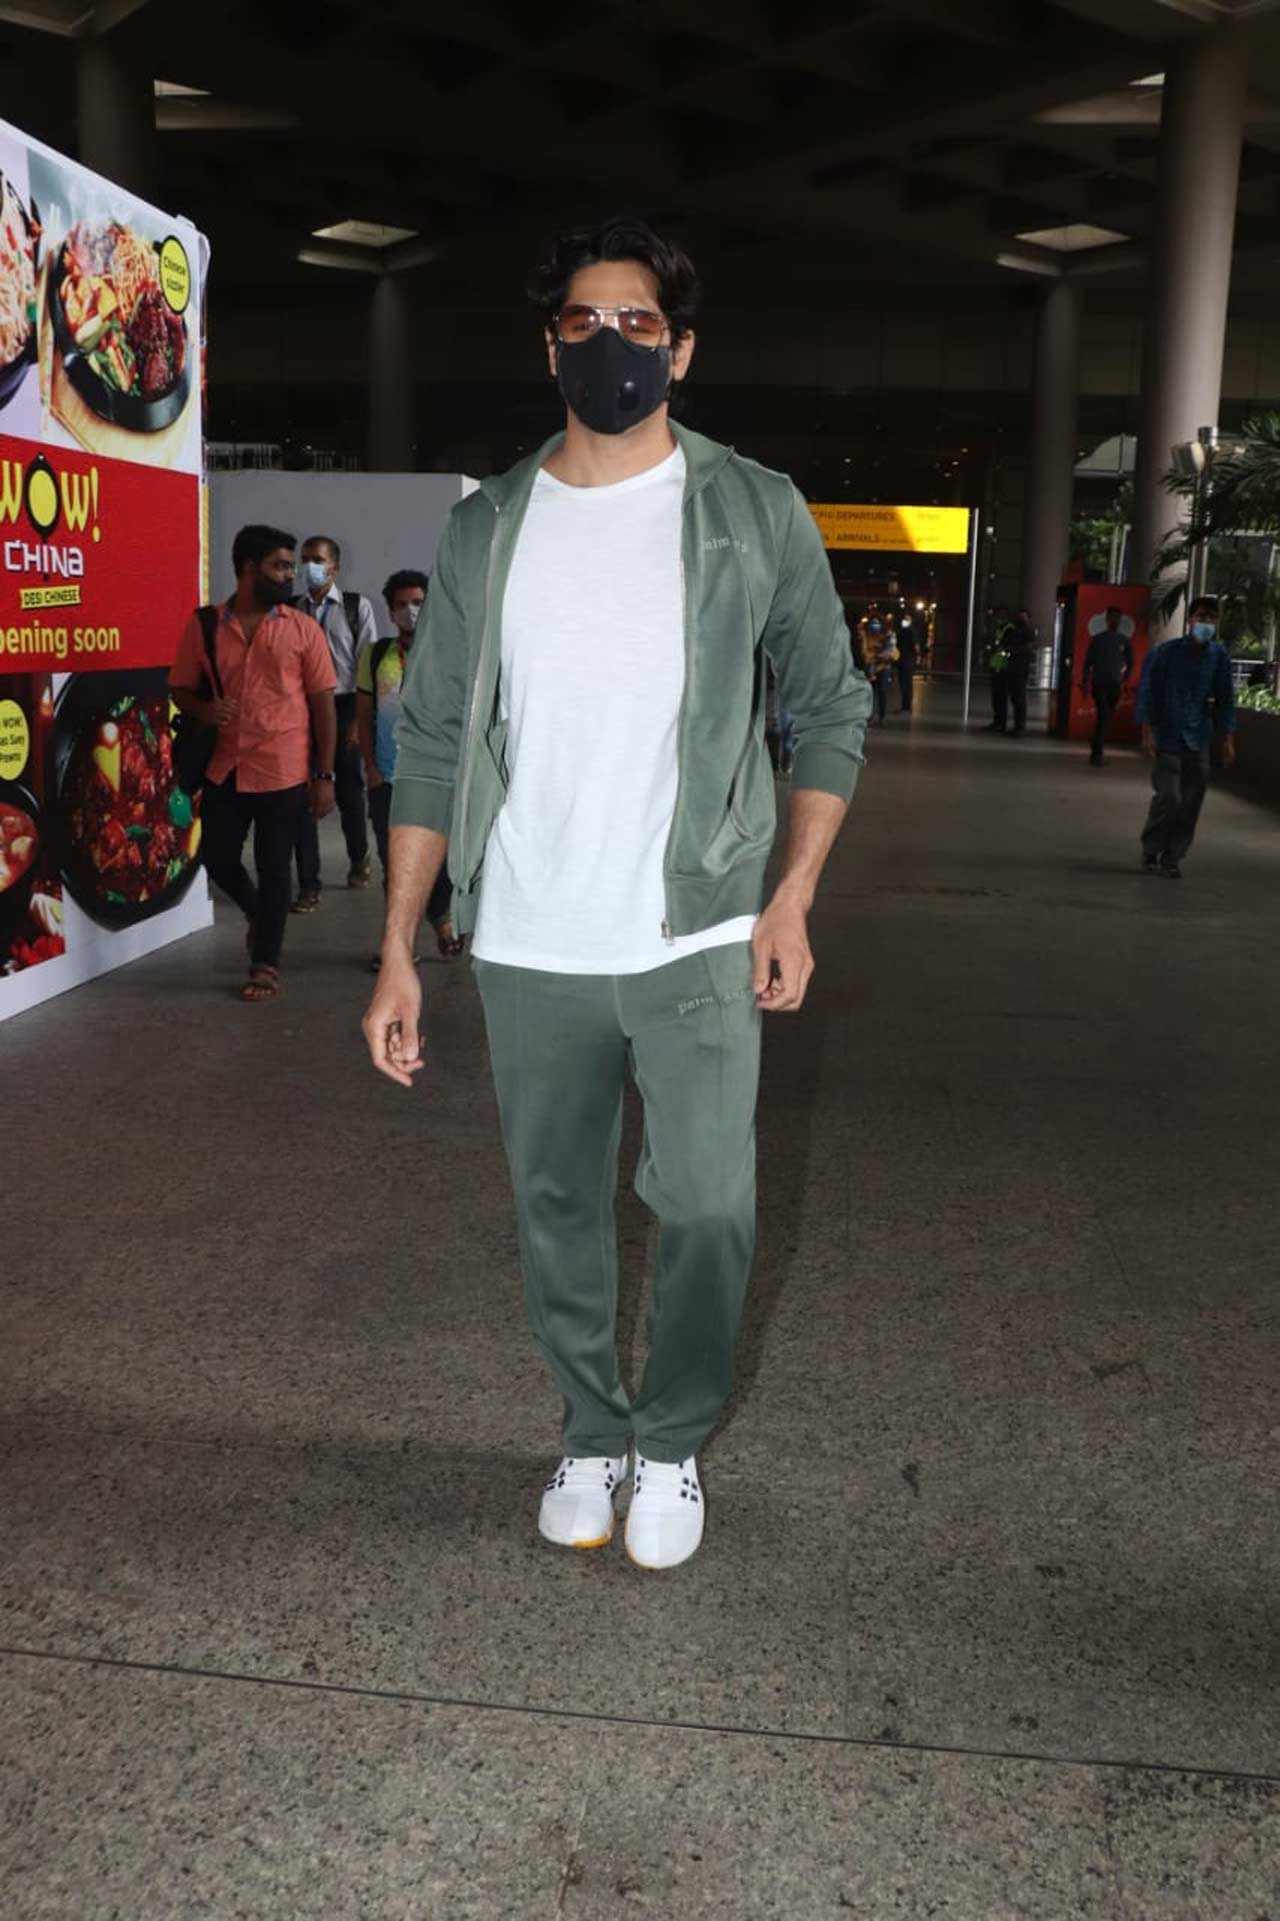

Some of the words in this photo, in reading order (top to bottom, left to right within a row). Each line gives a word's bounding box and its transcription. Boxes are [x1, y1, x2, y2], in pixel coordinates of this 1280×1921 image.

[24, 591, 42, 606] DESI
[45, 589, 78, 603] CHINESE
[74, 627, 120, 652] soon
